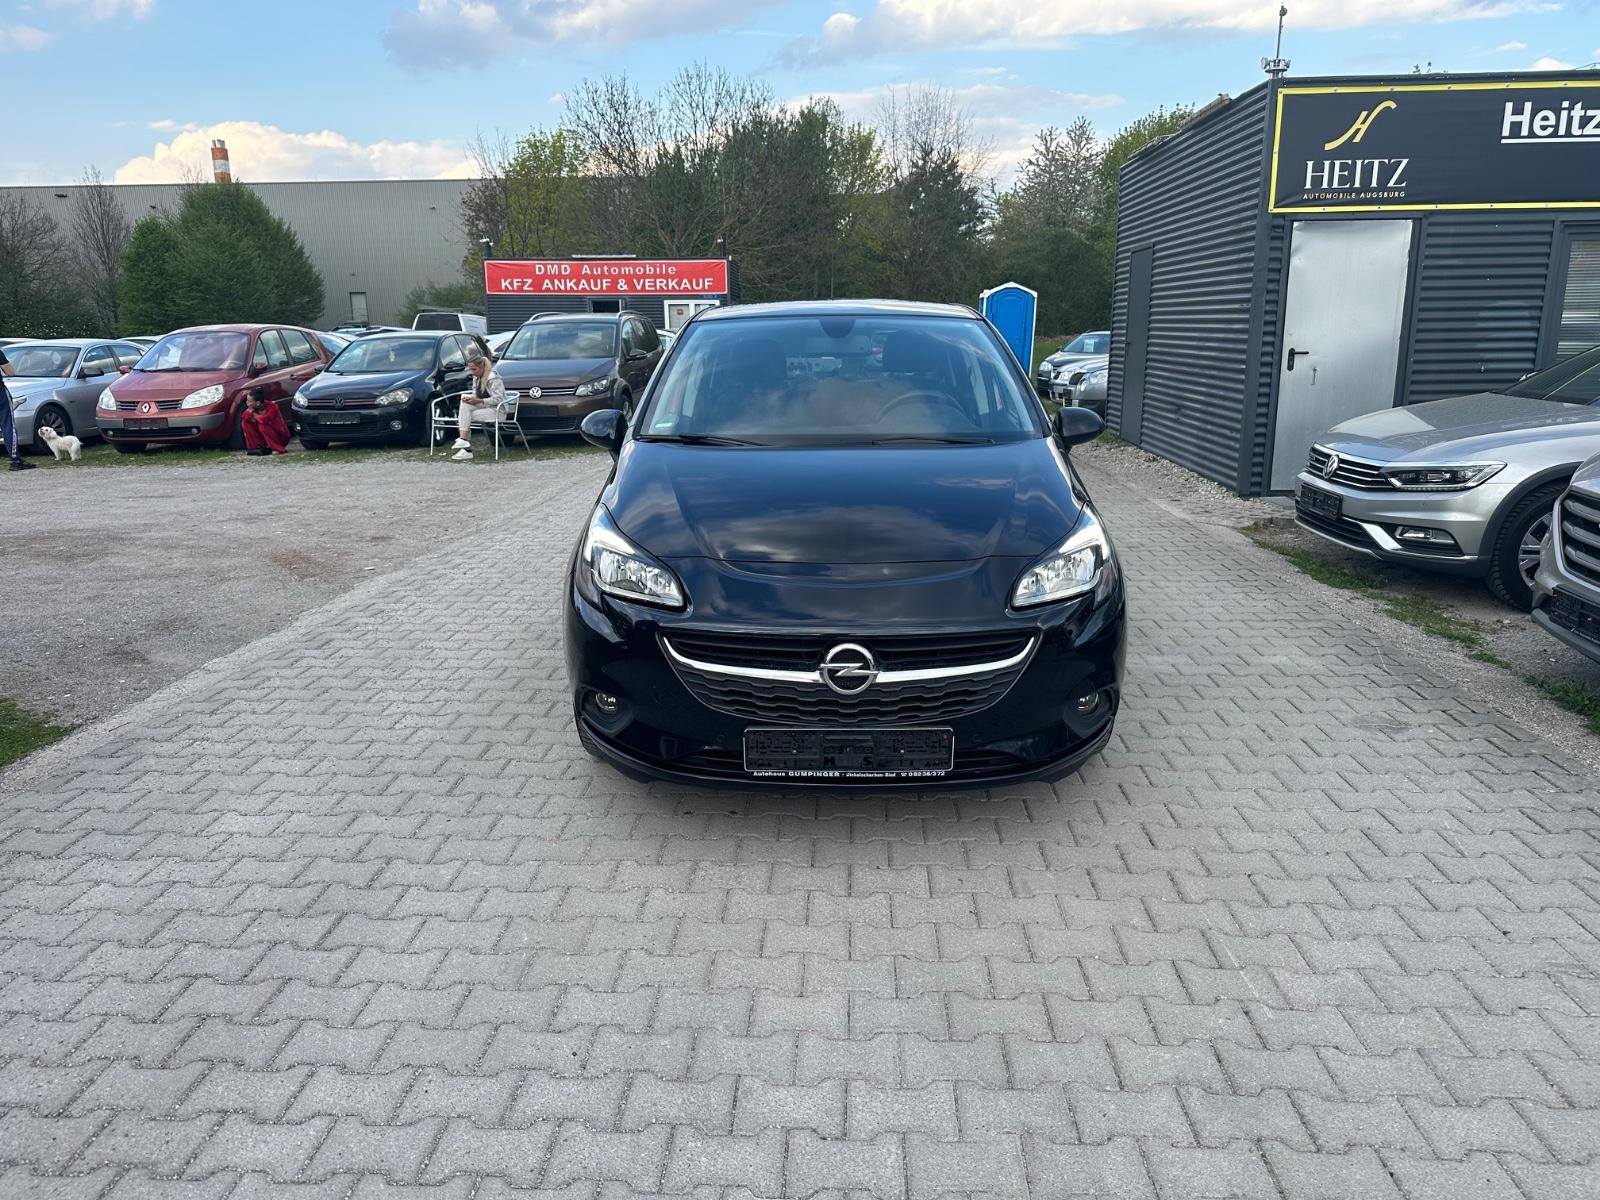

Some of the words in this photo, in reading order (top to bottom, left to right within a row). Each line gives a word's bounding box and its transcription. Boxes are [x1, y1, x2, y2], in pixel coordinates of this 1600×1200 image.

[1501, 101, 1600, 137] Heitz
[1303, 158, 1409, 190] HEITZ
[535, 264, 571, 275] DMD
[581, 263, 677, 275] Automobile
[501, 279, 534, 291] KFZ
[542, 278, 611, 291] ANKAUF
[617, 279, 629, 291] &
[633, 278, 714, 291] VERKAUF
